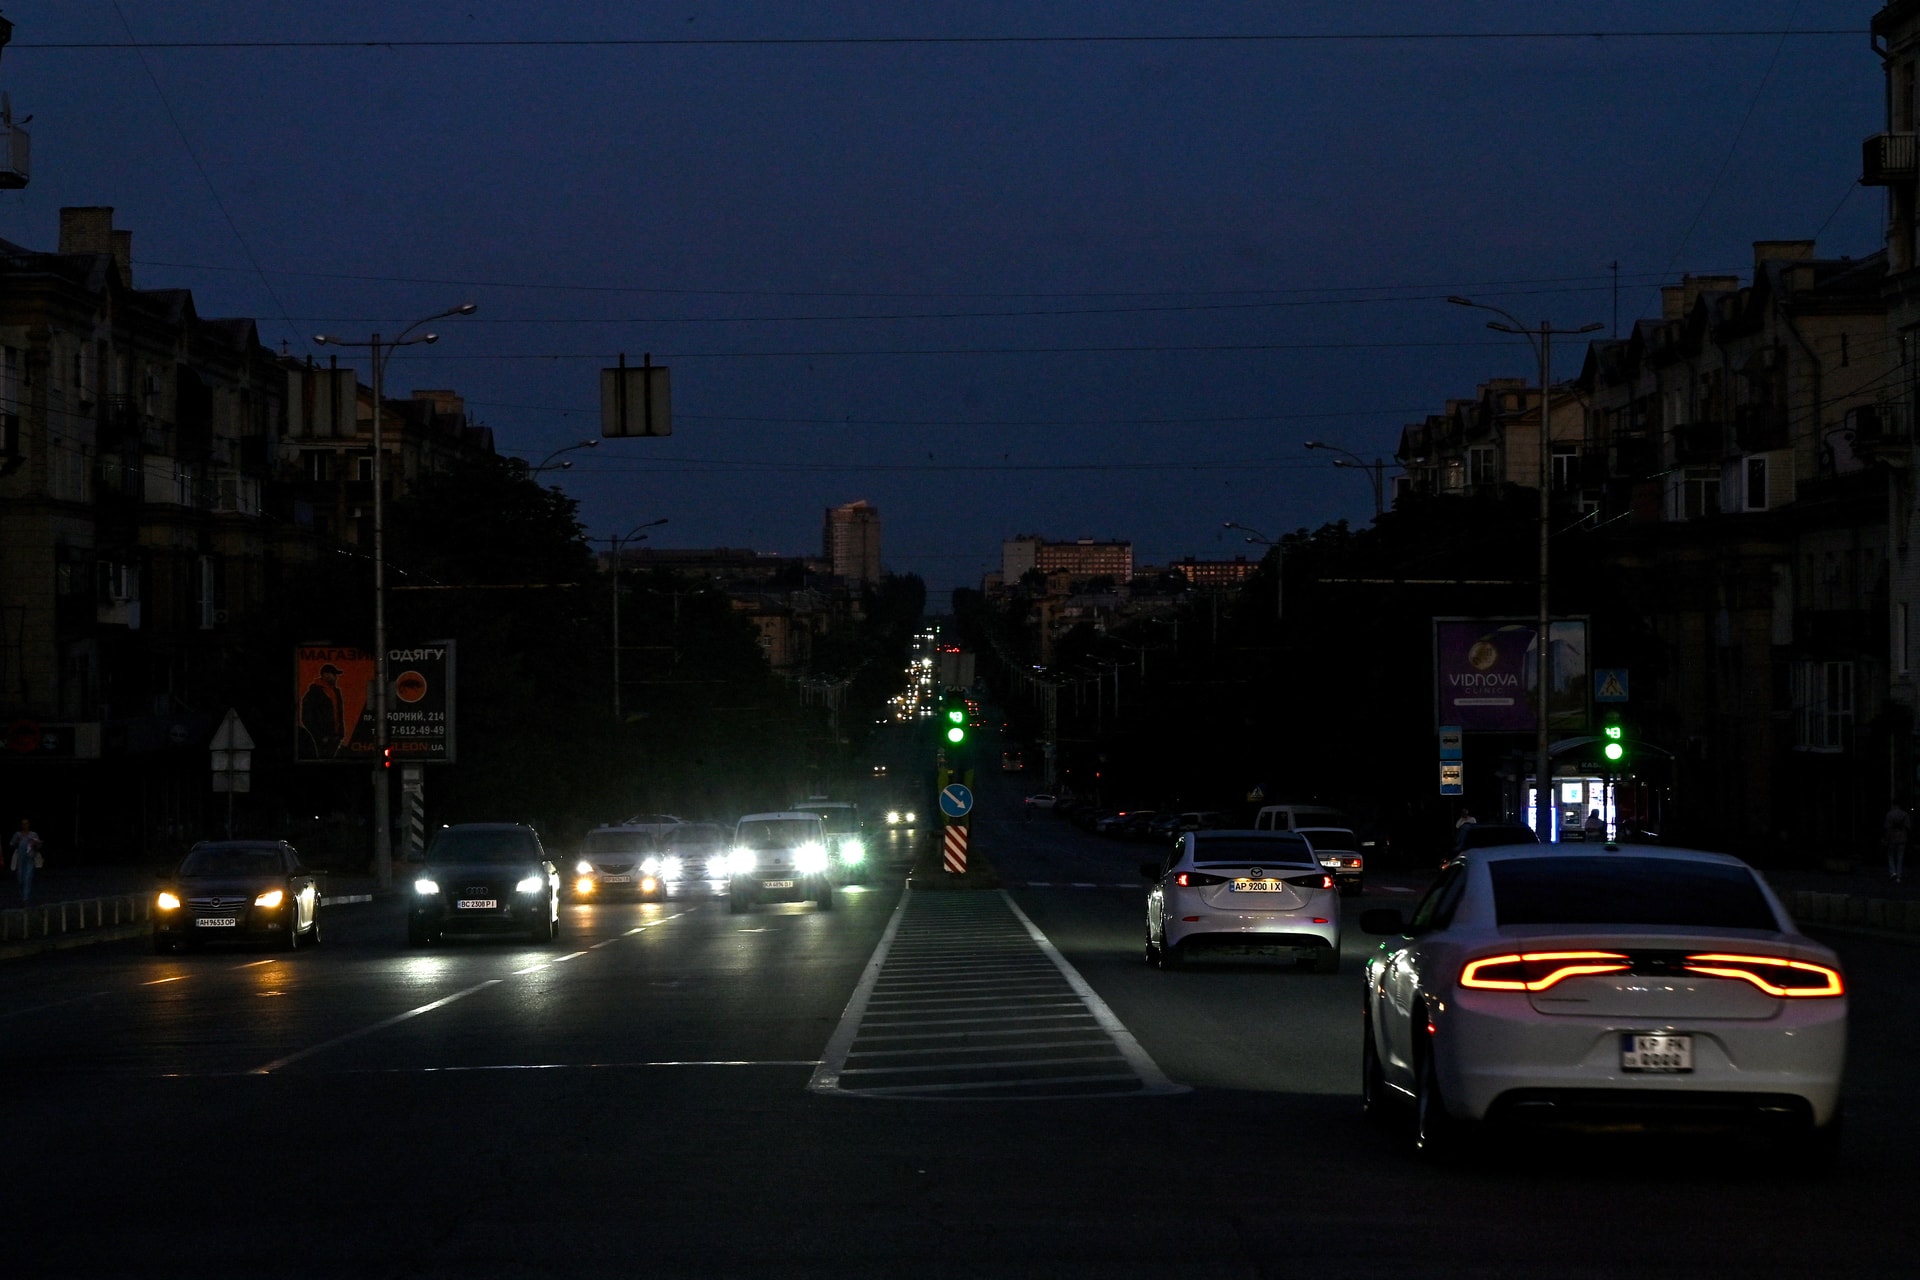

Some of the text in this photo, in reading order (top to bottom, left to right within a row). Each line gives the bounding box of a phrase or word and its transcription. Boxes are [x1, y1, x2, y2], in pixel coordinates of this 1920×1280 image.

[390, 649, 444, 662] ОДЯГУ
[1449, 673, 1519, 687] VIDNOVA
[1464, 687, 1503, 695] CLINIC
[428, 712, 444, 721] 214
[1249, 882, 1267, 891] 9200
